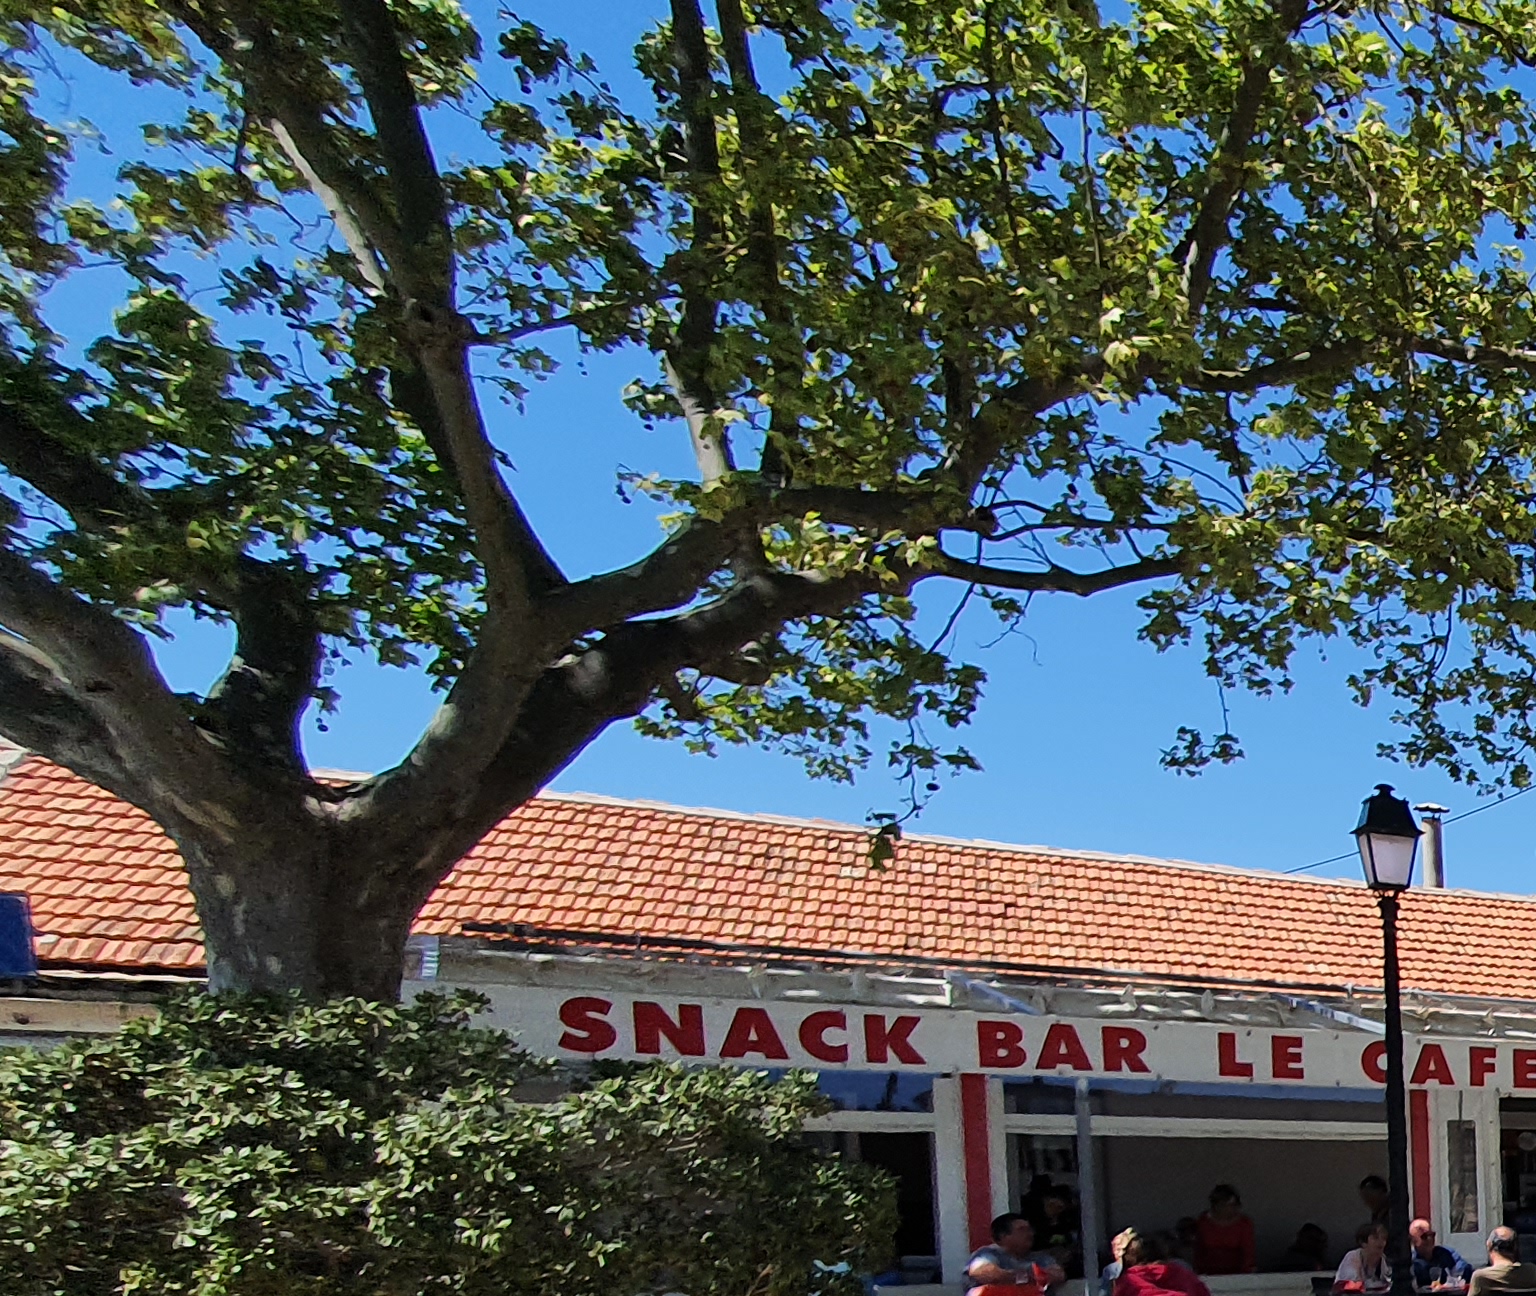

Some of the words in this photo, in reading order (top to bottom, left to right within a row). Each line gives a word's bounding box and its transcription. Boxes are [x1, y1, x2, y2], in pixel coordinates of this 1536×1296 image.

[558, 996, 926, 1065] SNACK
[977, 1020, 1150, 1073] BAR
[1218, 1031, 1305, 1080] LE
